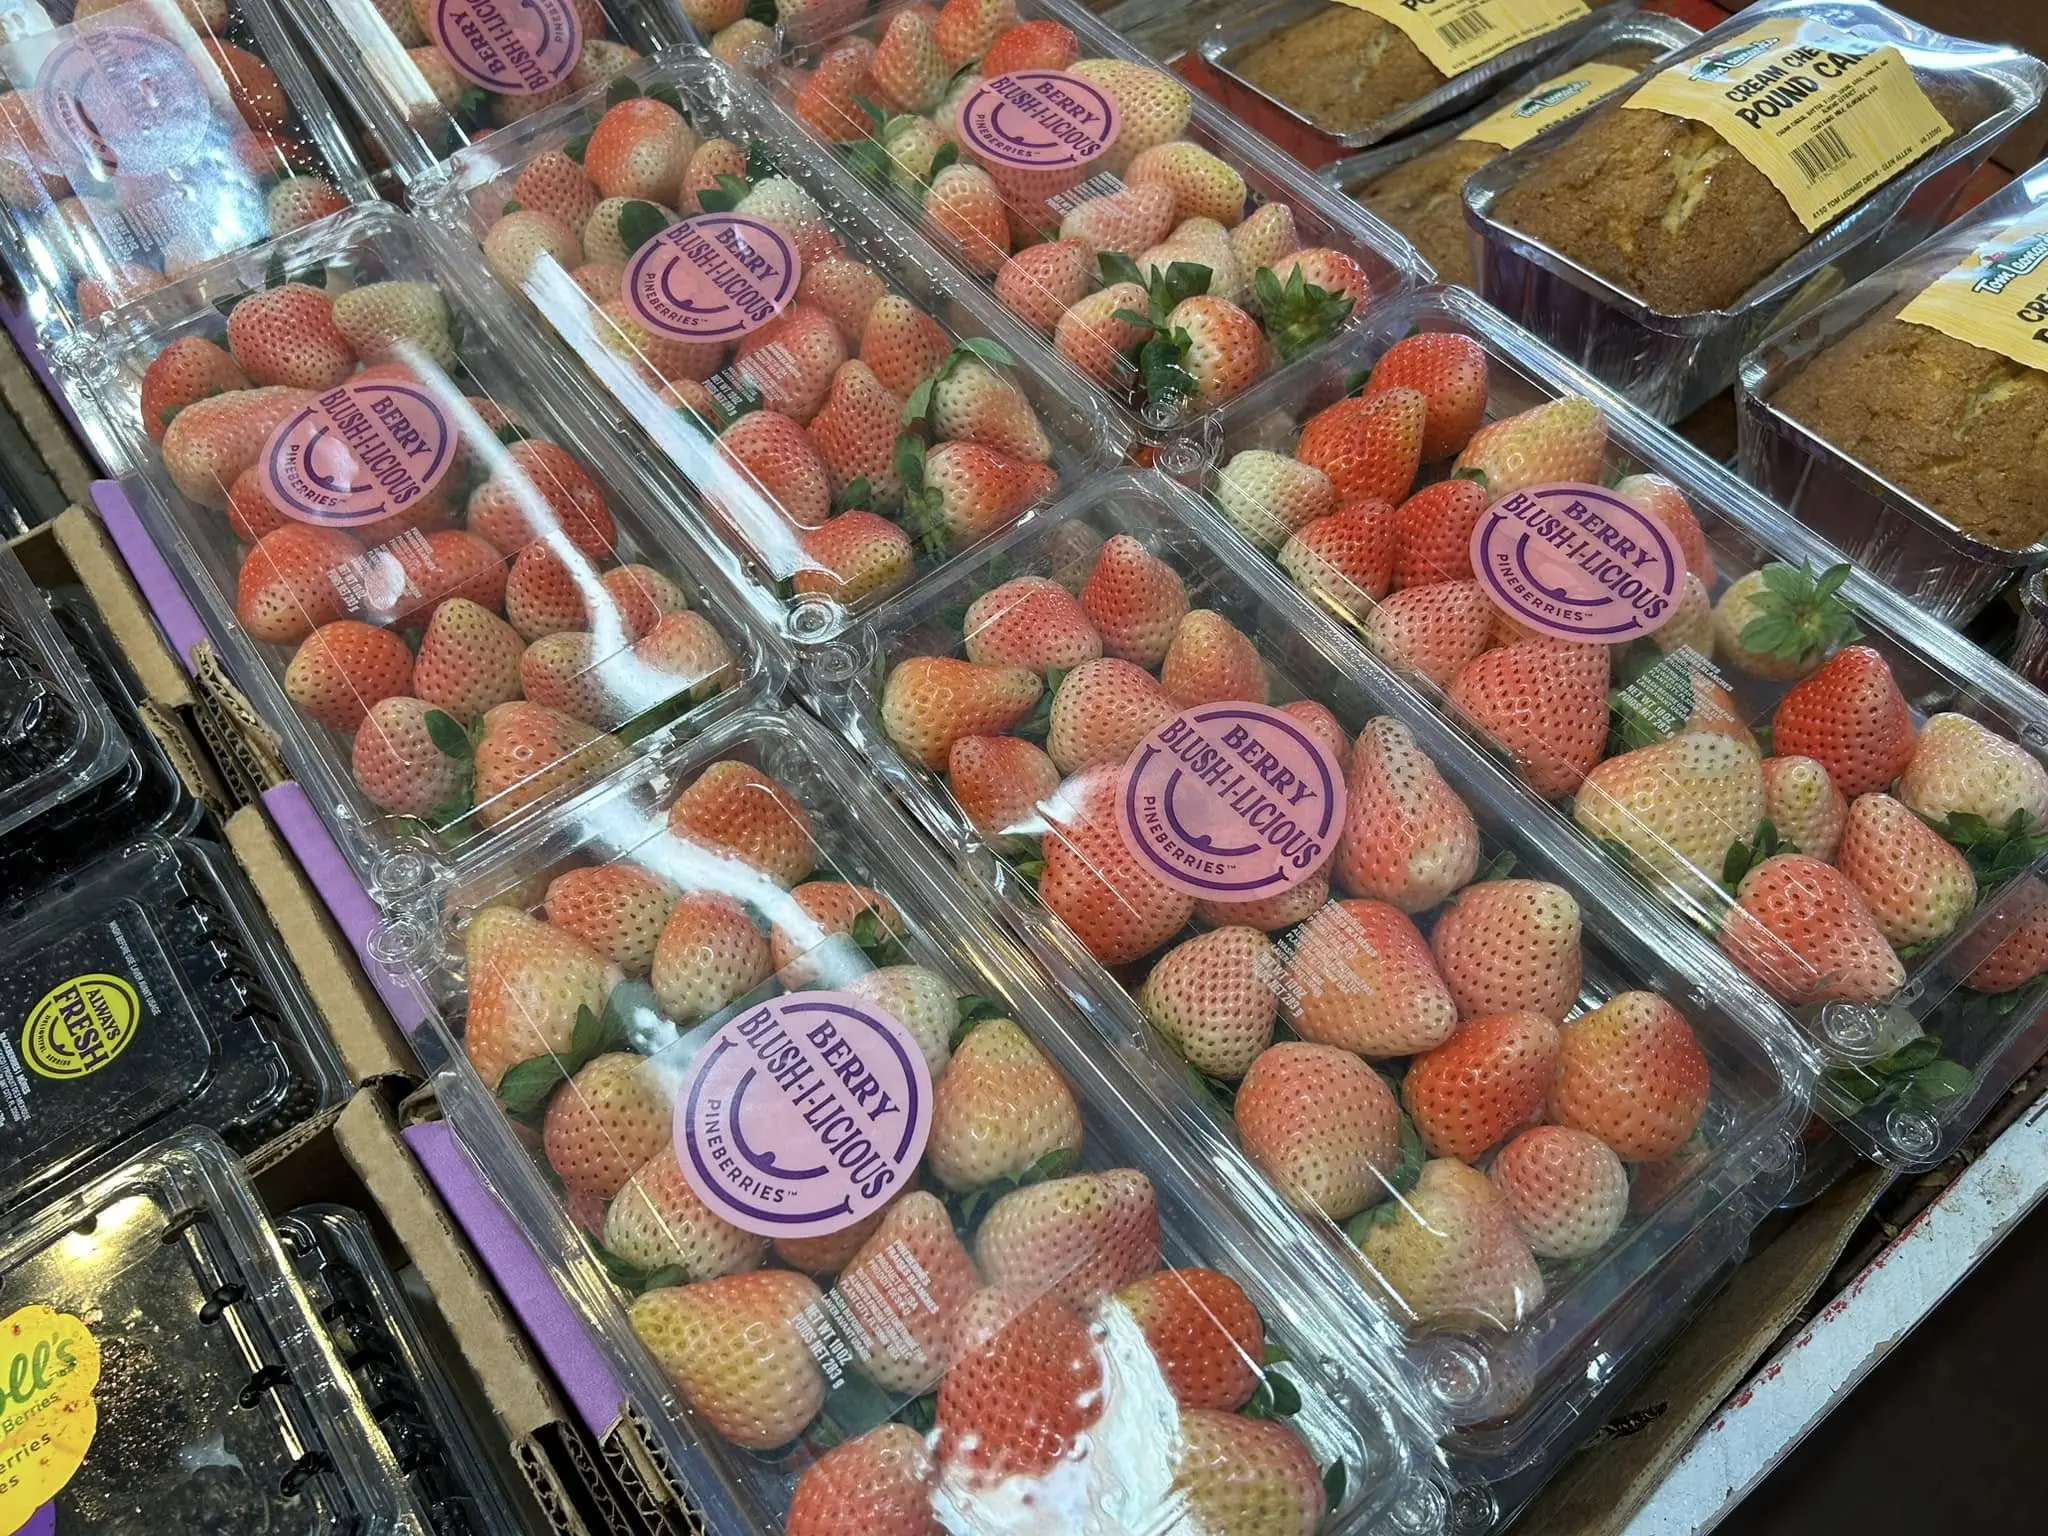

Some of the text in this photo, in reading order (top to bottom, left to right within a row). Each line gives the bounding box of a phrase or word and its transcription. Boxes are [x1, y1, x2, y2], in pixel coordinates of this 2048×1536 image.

[450, 11, 506, 74] BERRY
[1035, 81, 1100, 125] BERRY
[1725, 64, 1789, 103] CREAM
[1781, 44, 1825, 68] CHE
[1734, 75, 1819, 129] POUND
[1814, 51, 1869, 79] CA
[989, 76, 1100, 157] BLUSH-I-LICIOUS
[1894, 146, 1912, 161] ALLEN
[667, 222, 775, 322] BLUSH-I-LICIOUS
[714, 227, 779, 282] BERRY
[319, 388, 421, 504] BLUSH-I-LICIOUS
[370, 396, 432, 458] BERRY
[1502, 492, 1668, 619] BLUSH-I-LICIOUS
[1561, 500, 1658, 569] BERRY
[1626, 685, 1643, 698] NET
[1640, 696, 1658, 709] WT
[1639, 708, 1657, 721] NET
[1157, 717, 1322, 869] BLUSH-I-LICIOUS
[1221, 724, 1317, 807] BERRY
[1268, 979, 1287, 996] NET
[1272, 965, 1288, 979] WT
[53, 984, 110, 1071] FRESH
[86, 988, 121, 1040] ALWAYS
[146, 996, 160, 1015] USAGE
[806, 1019, 901, 1122] BERRY
[736, 1006, 895, 1199] BLUSH-I-LICIOUS
[839, 1279, 858, 1302] PLANT
[874, 1252, 901, 1285] PRODUCT
[903, 1292, 919, 1310] USA
[803, 1303, 824, 1324] NET
[815, 1320, 836, 1342] WT
[819, 1293, 840, 1317] LAVER
[834, 1314, 855, 1339] AVANT
[827, 1287, 873, 1347] WASH BEFORE USE
[792, 1312, 817, 1344] POIDS
[810, 1340, 827, 1361] NET
[822, 1358, 842, 1380] 283
[3, 1391, 58, 1433] Berries
